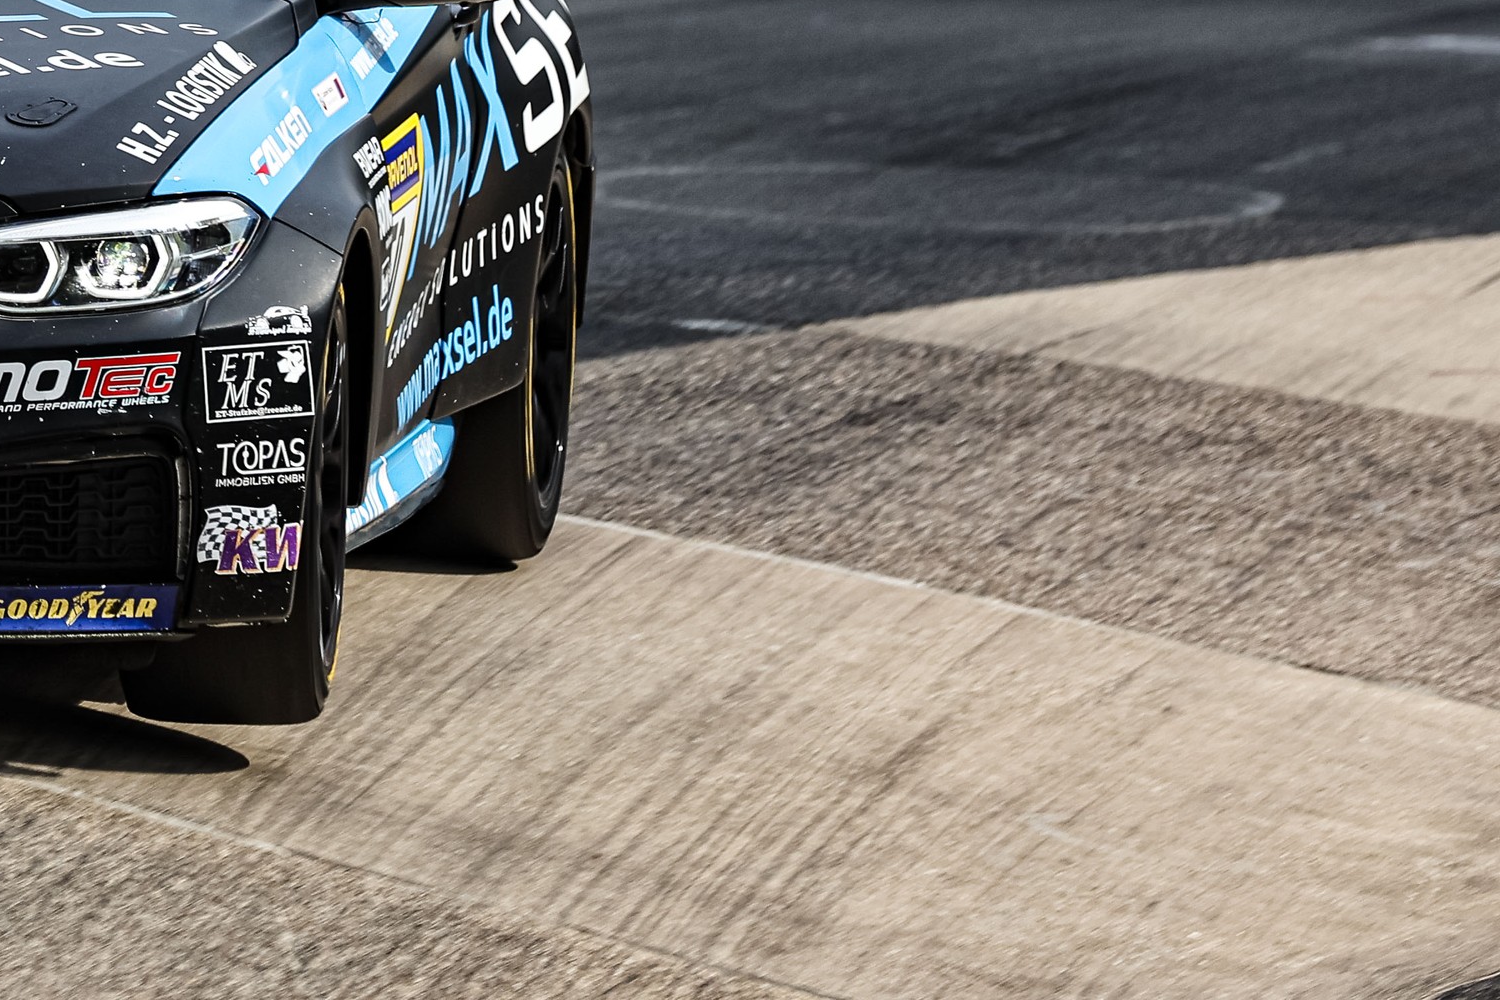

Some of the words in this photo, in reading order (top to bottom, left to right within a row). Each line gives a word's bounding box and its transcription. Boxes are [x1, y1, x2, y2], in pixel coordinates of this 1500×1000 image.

[116, 121, 180, 165] H.Z.
[156, 51, 243, 121] LOGISTIK
[249, 105, 313, 186] FALKEN
[428, 194, 545, 305] SOLUTIONS
[217, 351, 265, 383] ET
[27, 398, 117, 412] PERFORMANCE
[121, 394, 170, 406] WHEELS
[220, 377, 272, 410] MS
[216, 437, 306, 476] TOPAS
[215, 475, 275, 488] IMMOBILIEN
[277, 473, 306, 483] GMBH
[214, 522, 303, 576] KW
